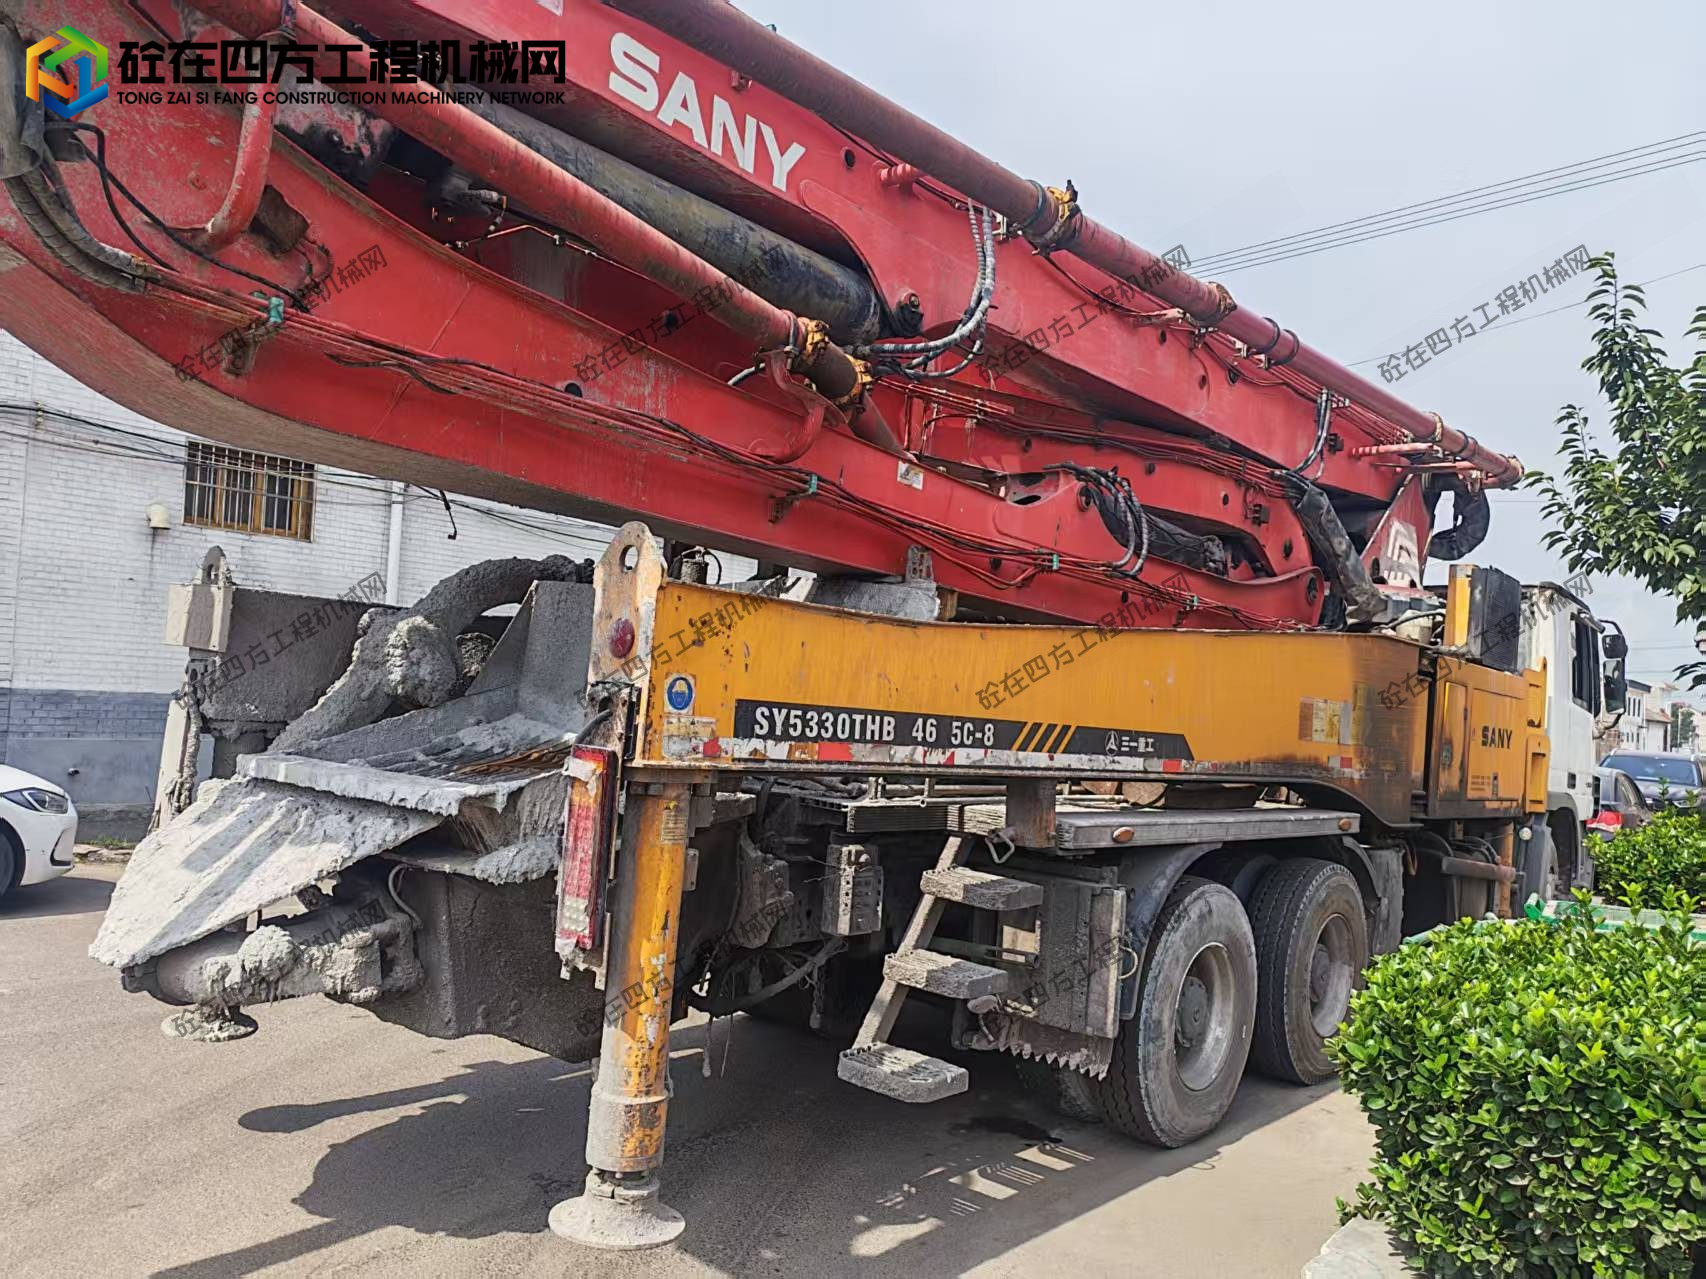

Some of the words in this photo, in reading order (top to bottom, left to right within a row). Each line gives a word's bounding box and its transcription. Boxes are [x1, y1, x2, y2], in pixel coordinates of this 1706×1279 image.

[609, 32, 806, 192] SANY
[754, 706, 896, 741] SY5330THB
[912, 717, 937, 742] 46
[951, 721, 994, 746] 5C-8
[1481, 725, 1513, 749] SANY
